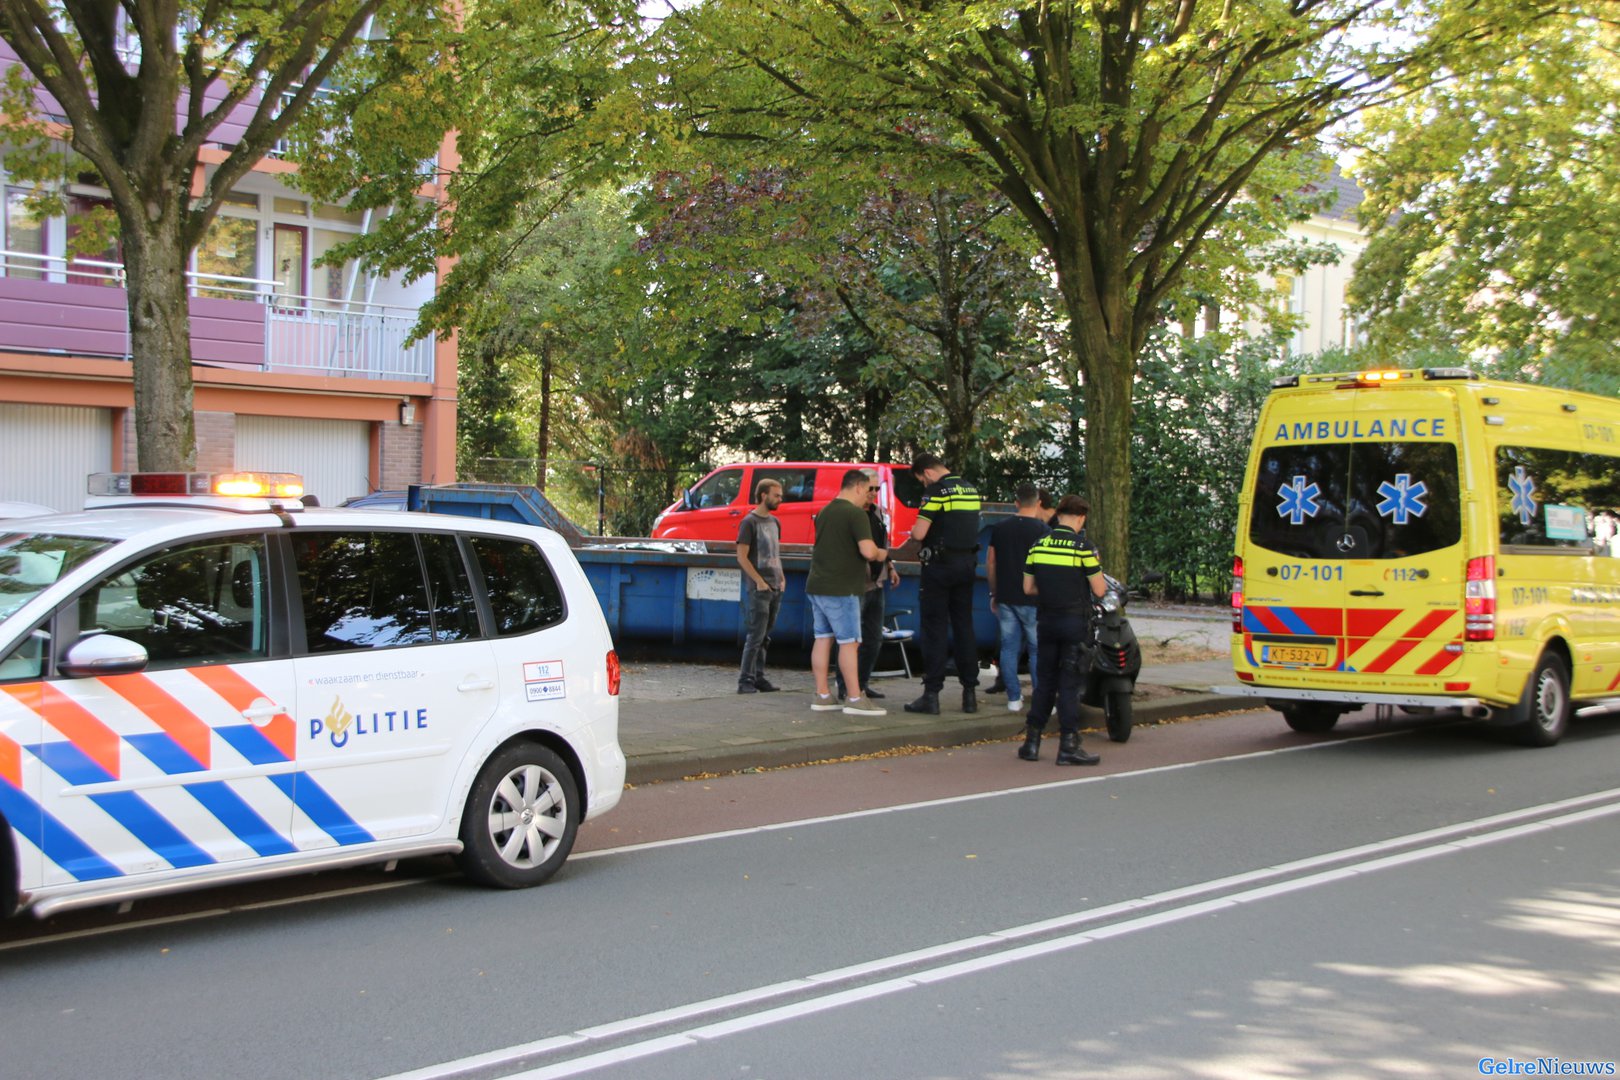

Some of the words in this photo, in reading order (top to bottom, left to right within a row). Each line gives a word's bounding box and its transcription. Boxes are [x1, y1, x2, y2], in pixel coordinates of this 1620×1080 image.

[1274, 418, 1446, 441] AMBULANCE
[1280, 564, 1343, 581] 07-101
[1512, 586, 1548, 605] 07-101
[1271, 648, 1322, 662] KT-532-V
[363, 673, 374, 683] en
[538, 665, 549, 675] 112
[310, 708, 428, 748] POLITIE
